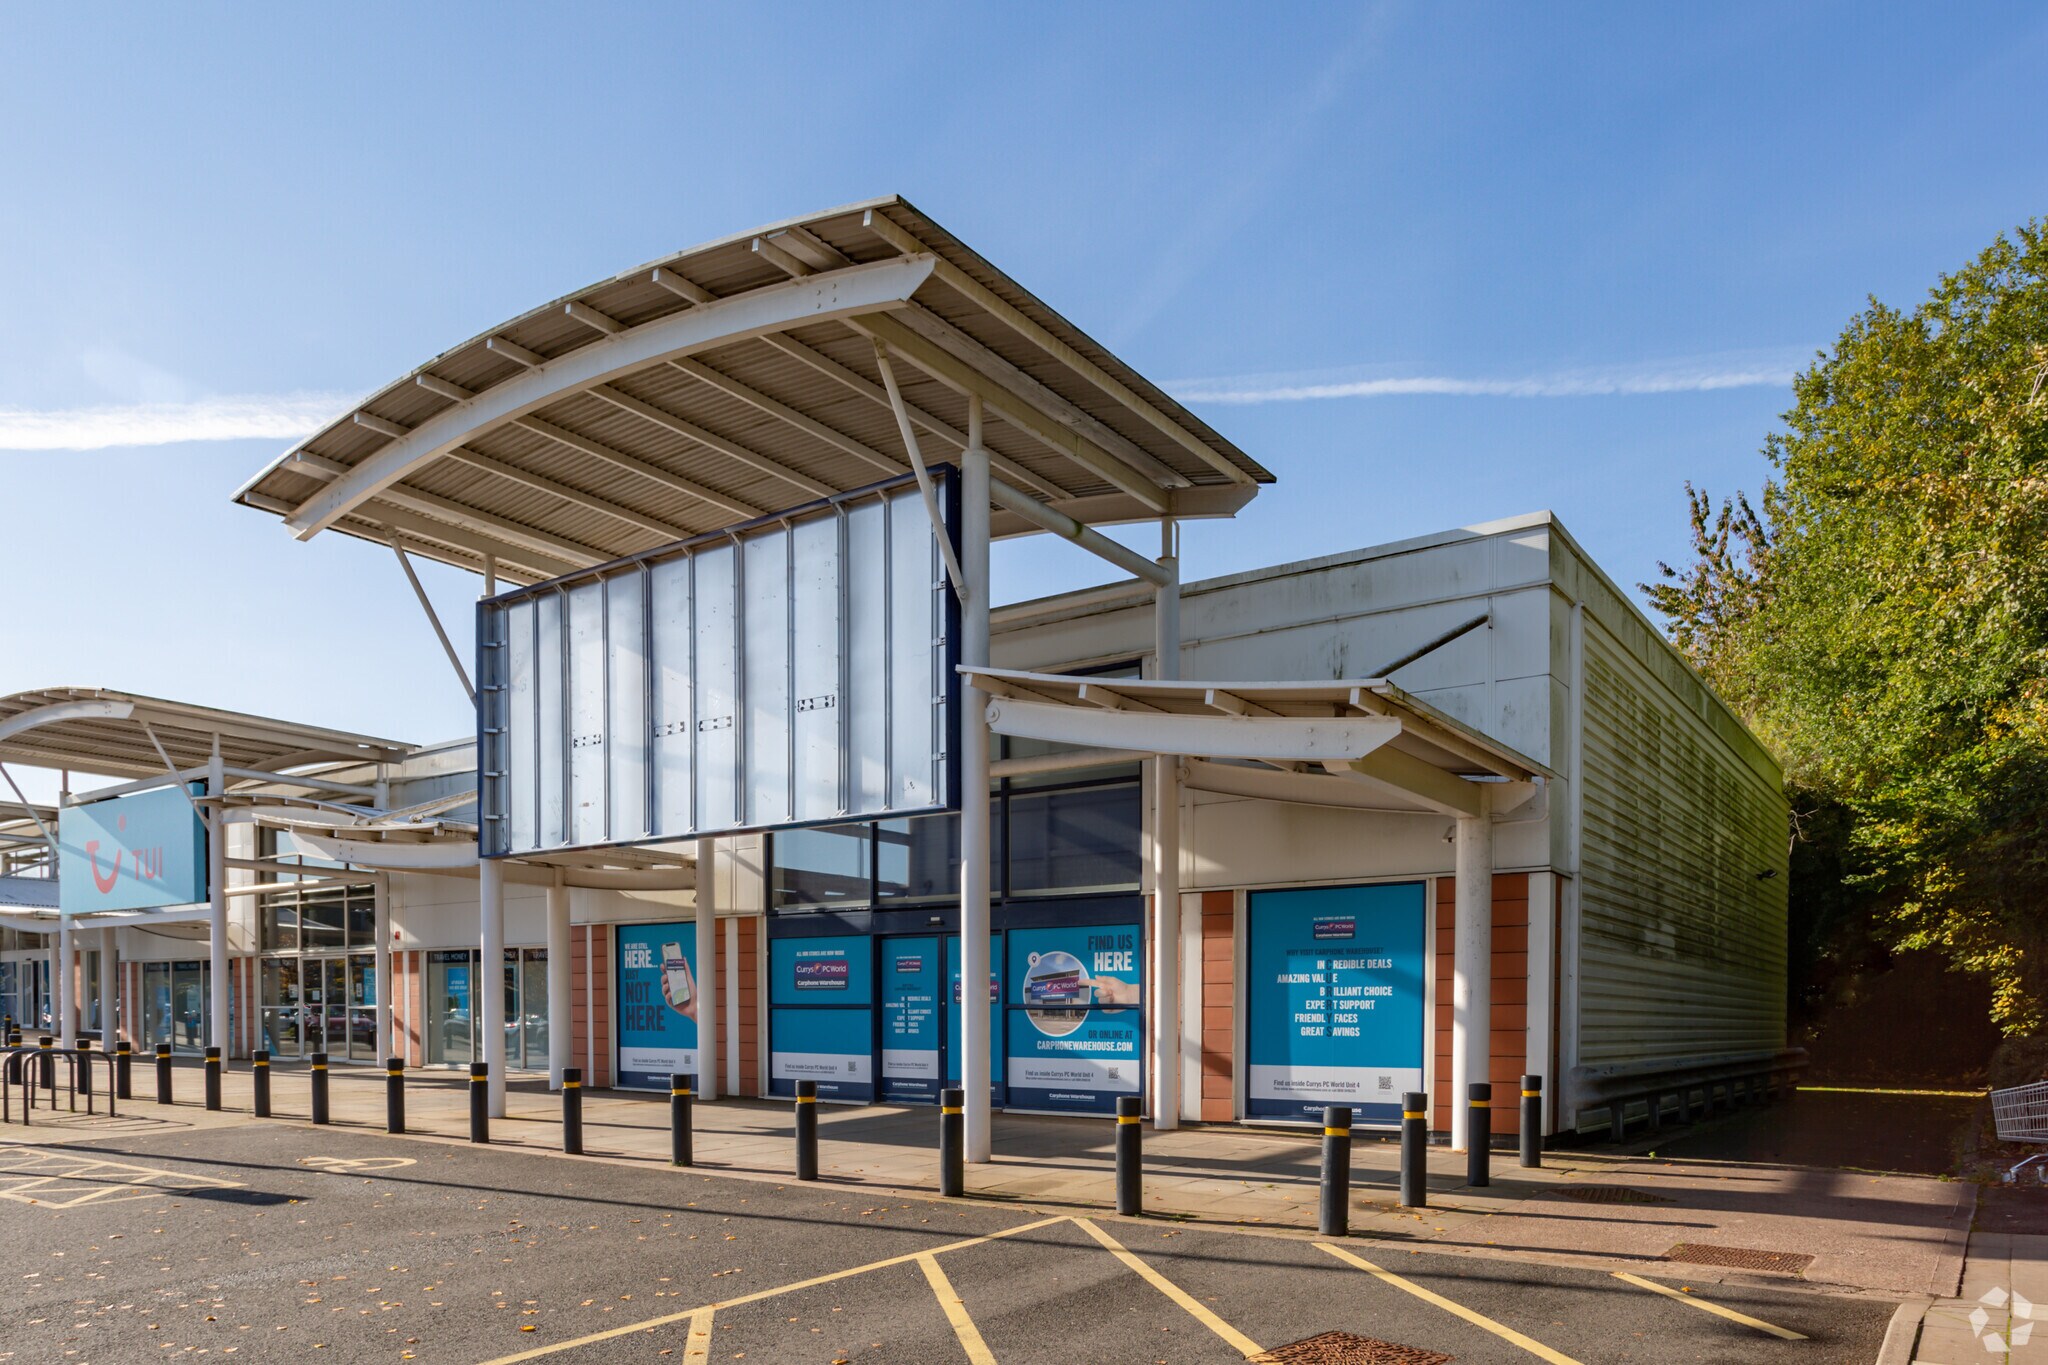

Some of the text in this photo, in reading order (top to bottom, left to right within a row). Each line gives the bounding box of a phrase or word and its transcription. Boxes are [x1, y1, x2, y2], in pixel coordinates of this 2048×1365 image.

[132, 847, 162, 880] TUI
[1088, 934, 1133, 950] FIND US
[1094, 951, 1133, 972] HERE
[1367, 959, 1392, 968] DEALS
[796, 966, 814, 974] Currys
[1277, 974, 1310, 983] AMAZING
[626, 982, 651, 1003] NOT
[1364, 986, 1392, 996] CHOICE
[1340, 1000, 1375, 1010] SUPPORT
[626, 1005, 665, 1031] HERE
[1334, 1014, 1358, 1023] FACES
[1088, 1030, 1133, 1039] OR ONLINE AT
[1301, 1027, 1324, 1036] GREAT
[1037, 1041, 1133, 1052] CARPHONEWAREHOUSE.COM
